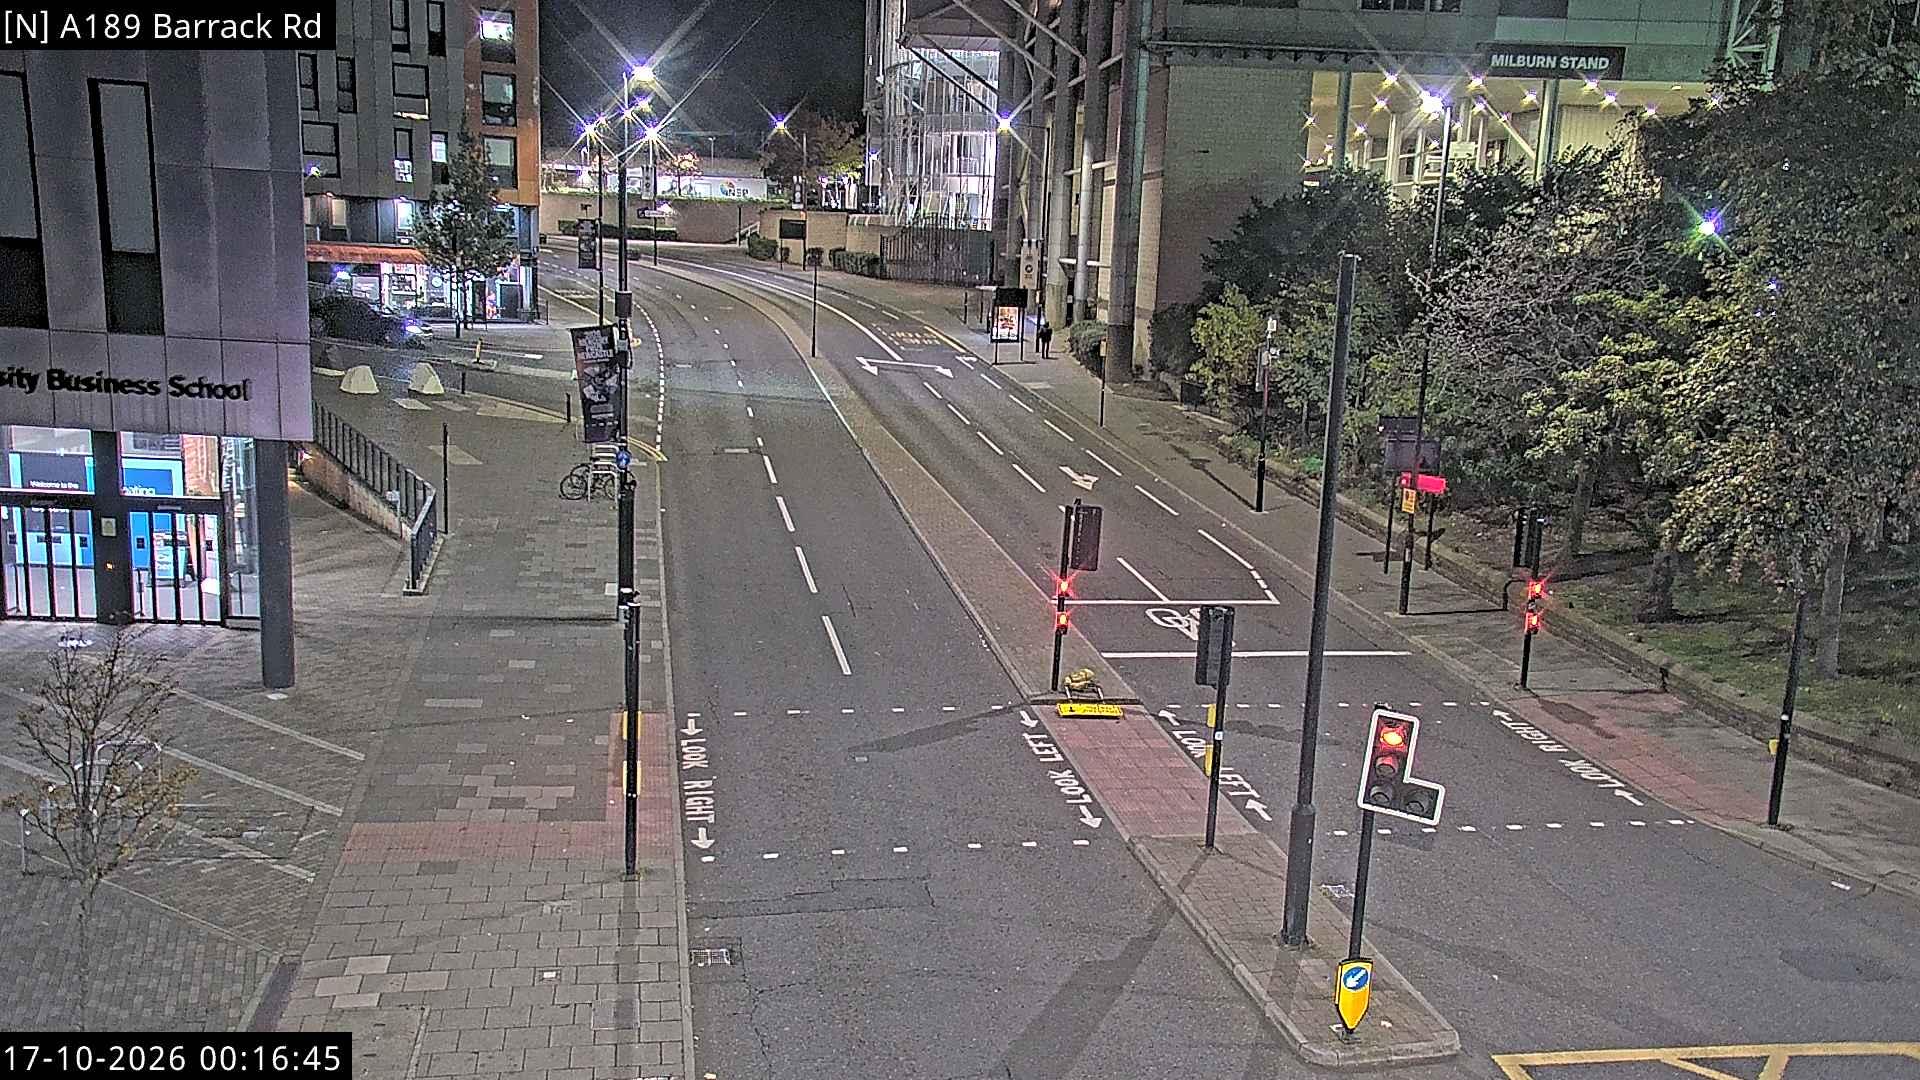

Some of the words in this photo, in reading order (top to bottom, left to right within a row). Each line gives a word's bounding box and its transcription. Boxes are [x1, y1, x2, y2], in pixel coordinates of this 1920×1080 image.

[1490, 54, 1557, 69] MILBURN
[1559, 56, 1610, 70] STAND
[46, 367, 162, 397] Business
[167, 373, 254, 401] School
[1022, 732, 1065, 763] LEFT
[1500, 718, 1570, 753] RIGHT
[680, 738, 709, 770] LOOK
[1048, 769, 1093, 804] LOOK
[1558, 758, 1626, 789] LOOK
[683, 779, 716, 824] RIGHT
